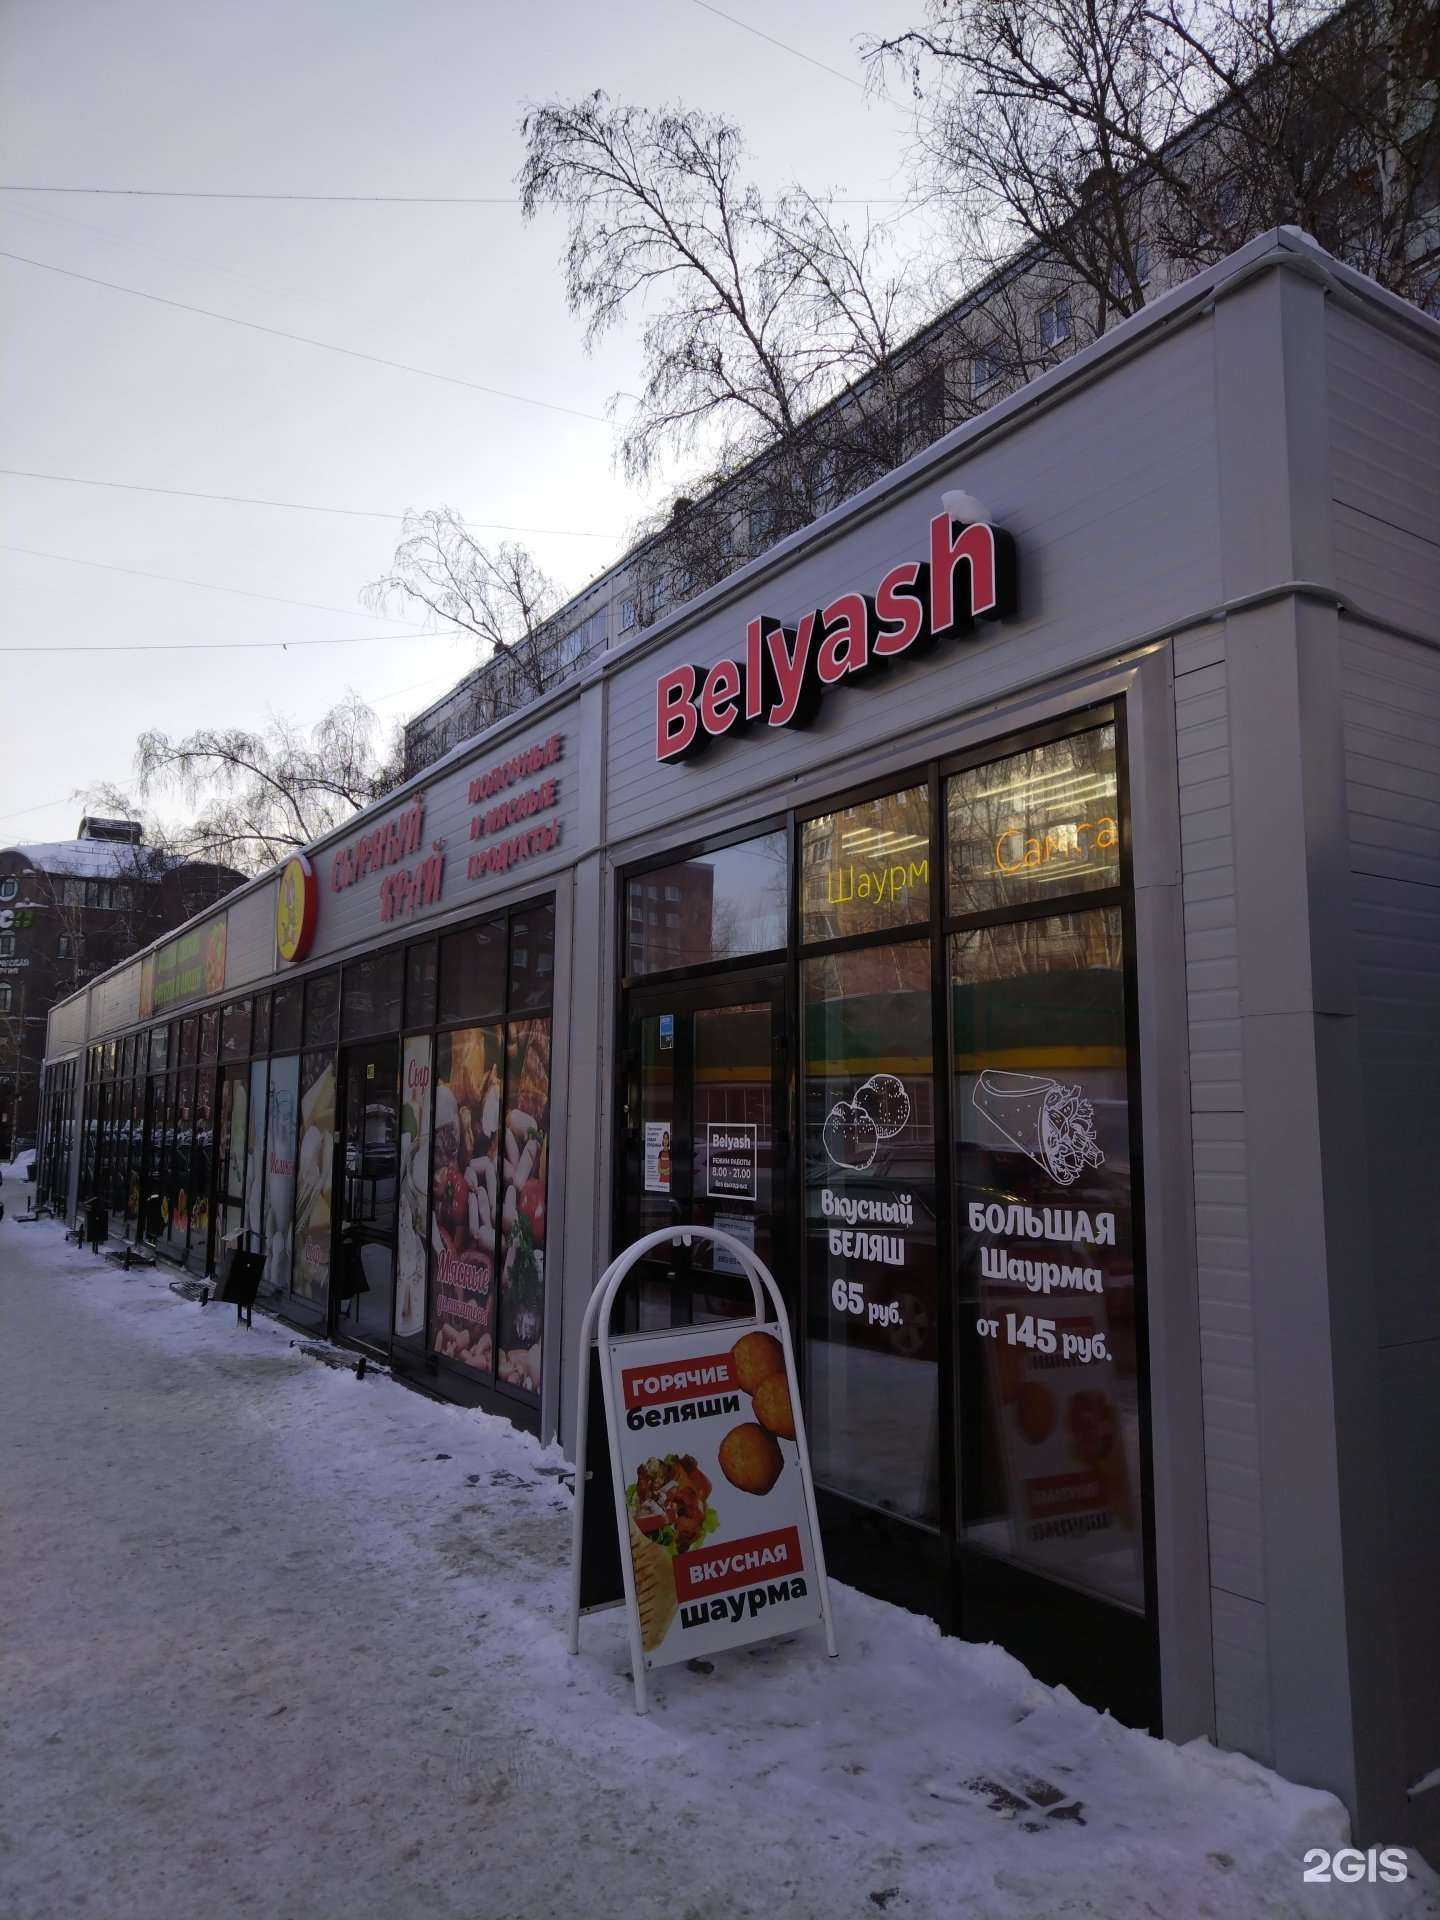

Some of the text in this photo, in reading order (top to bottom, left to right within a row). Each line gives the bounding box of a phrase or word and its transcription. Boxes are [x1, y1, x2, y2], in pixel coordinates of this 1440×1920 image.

[656, 512, 997, 763] Belyash
[468, 733, 562, 804] МОЛОЧНЫЕ
[486, 778, 559, 834] МЯСНЫЕ
[330, 790, 424, 893] СЫРНЫЙ
[467, 817, 560, 880] ПРОДУКТЫ
[379, 837, 446, 922] КРАЙ
[828, 859, 928, 905] Шаурм
[712, 1133, 750, 1150] Belyash
[712, 1167, 727, 1177] 8.00
[733, 1168, 751, 1178] 21.00
[821, 1189, 914, 1229] Вкусный
[968, 1202, 1116, 1246] БОЛЬШАЯ
[437, 1247, 490, 1295] Мясные
[828, 1229, 905, 1266] БЕЛЯШ
[980, 1247, 1104, 1294] Шаурма
[831, 1278, 903, 1328] 65 руб.
[976, 1318, 999, 1339] от
[1006, 1313, 1057, 1354] 145
[1062, 1332, 1112, 1362] руб.
[632, 1365, 730, 1397] ГОРЯЧИЕ
[626, 1394, 740, 1431] беляши
[689, 1543, 788, 1585] ВКУСНАЯ
[680, 1577, 808, 1629] шаурма
